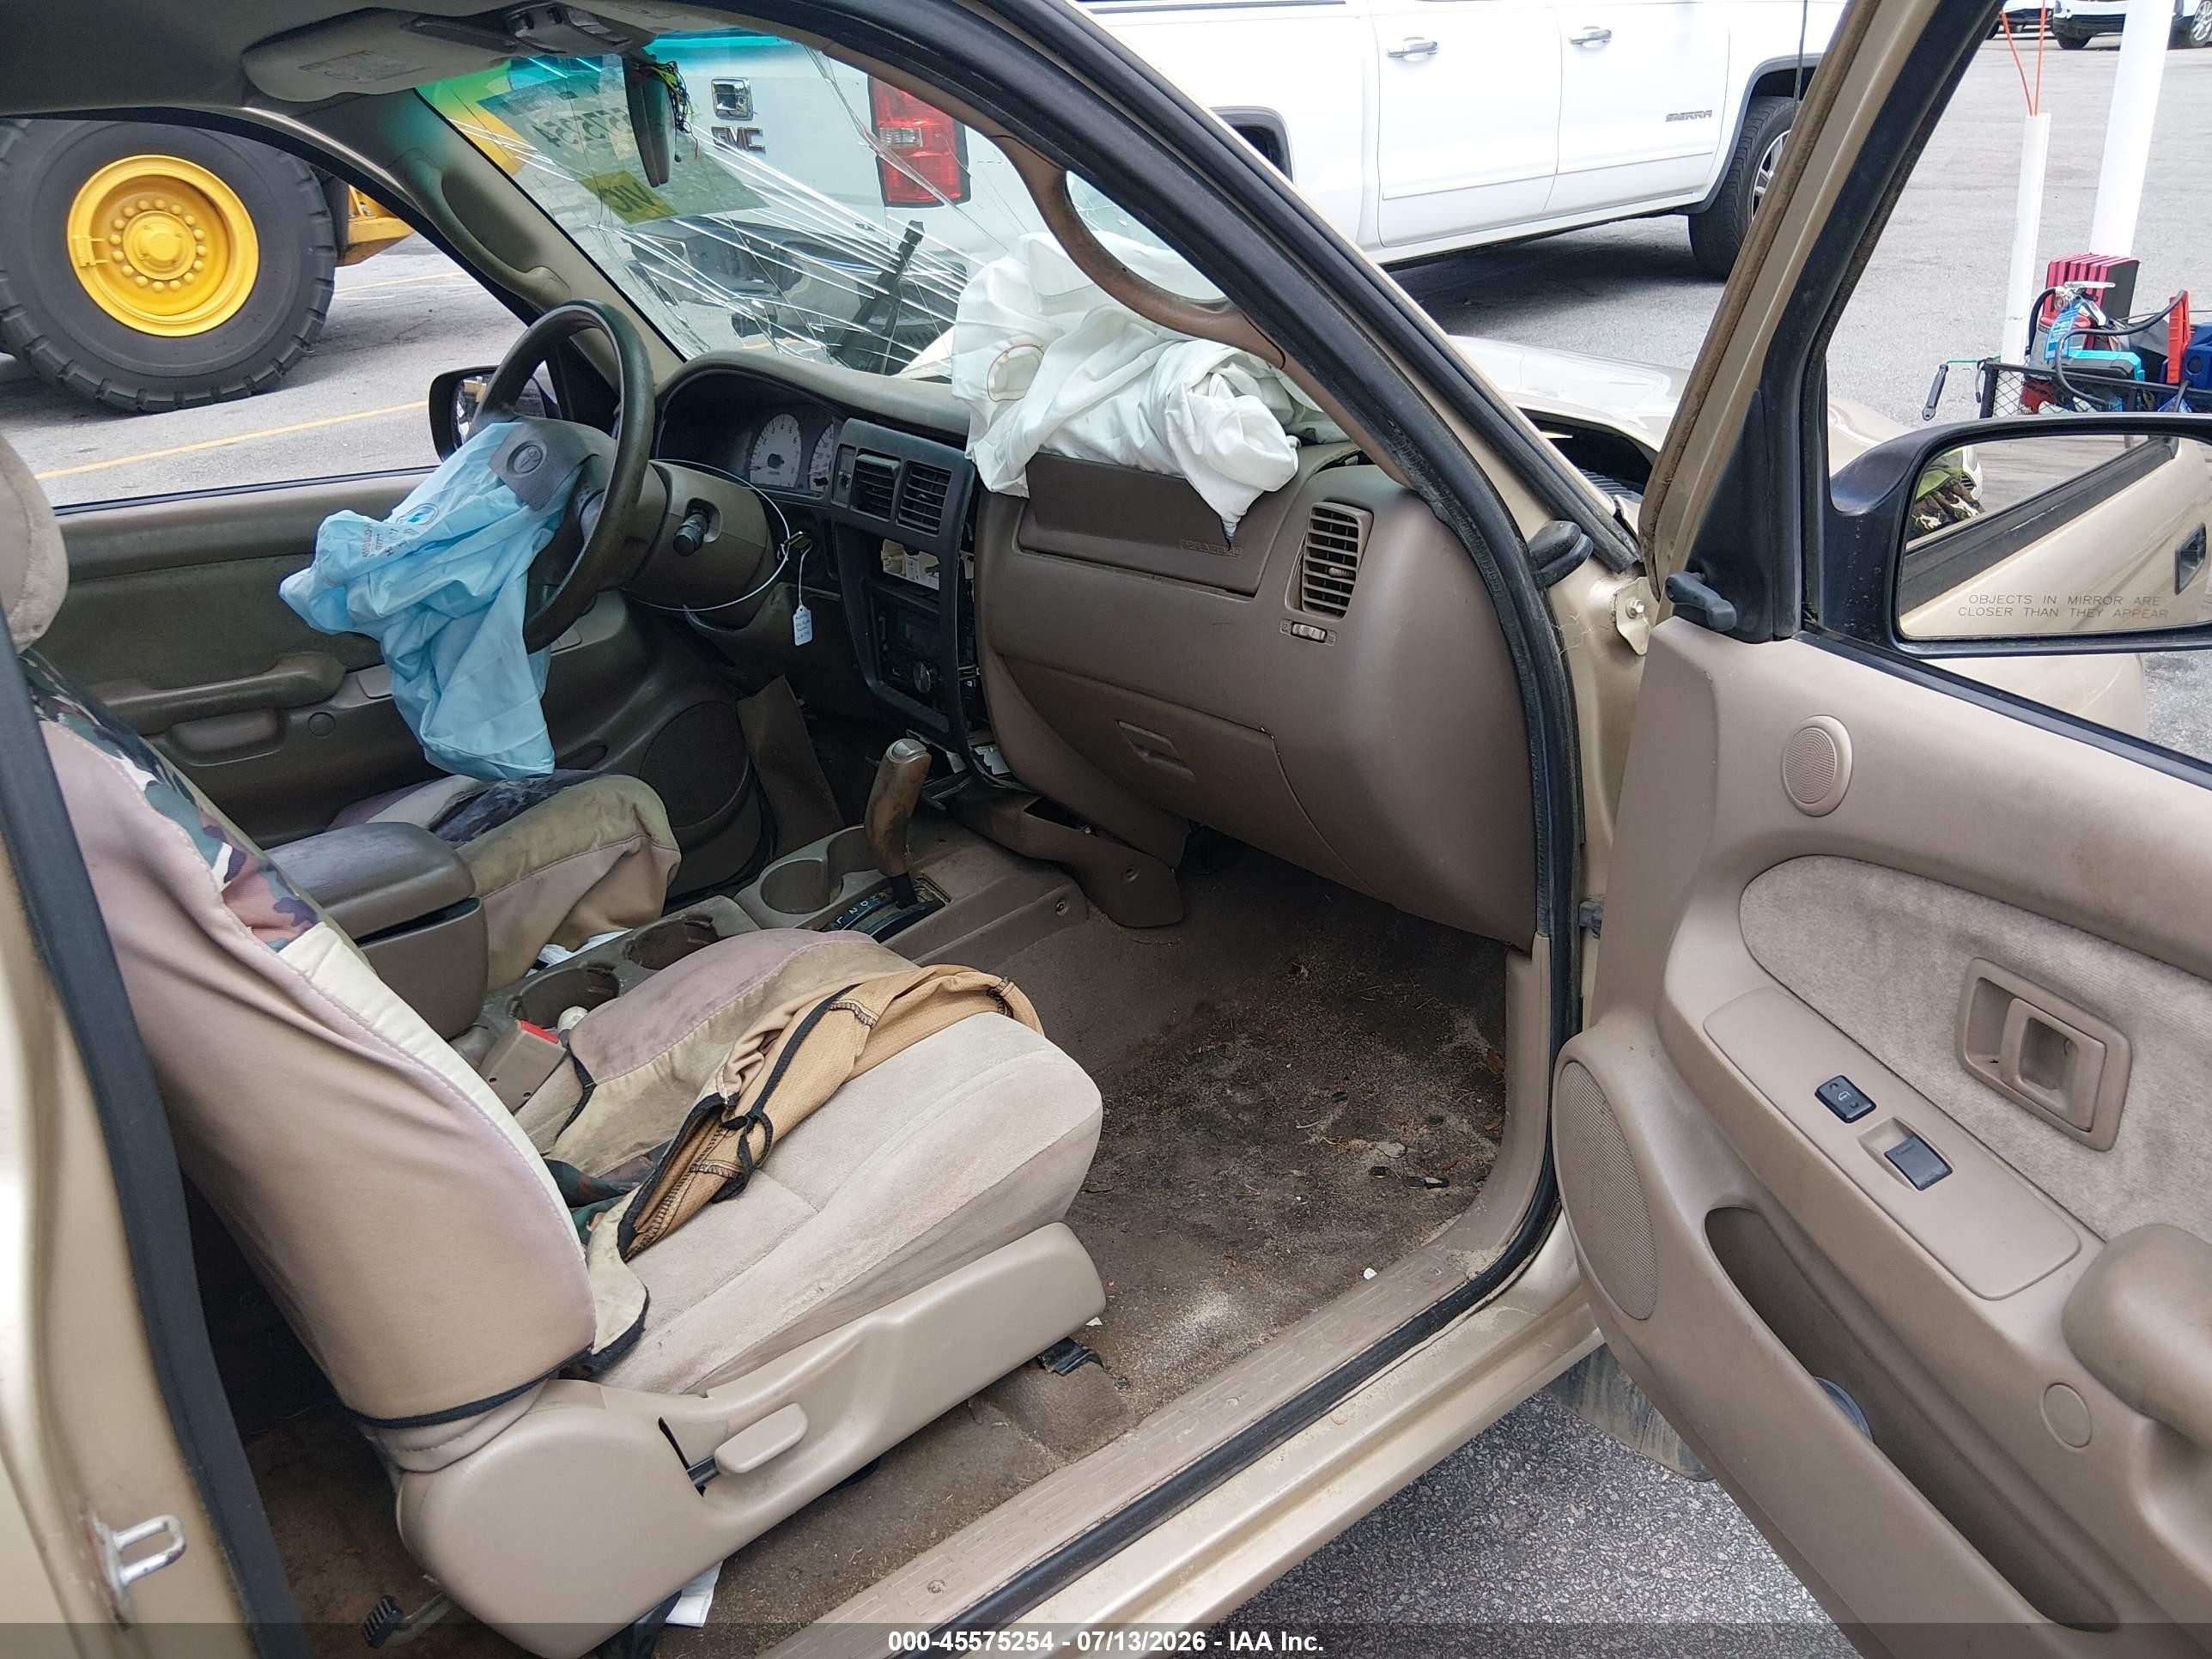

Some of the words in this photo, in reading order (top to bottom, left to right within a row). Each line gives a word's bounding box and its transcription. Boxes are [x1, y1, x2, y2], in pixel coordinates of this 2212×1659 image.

[1666, 110, 1712, 122] SIERRA
[711, 126, 766, 154] GMC
[1968, 594, 2033, 605] OBJECTS
[2043, 595, 2057, 604] IN
[2067, 595, 2124, 605] MIRROR
[2132, 596, 2161, 606] ARE
[1958, 606, 2014, 617] CLOSER
[2022, 607, 2059, 617] THAN
[2069, 607, 2104, 618] THEY
[2112, 608, 2169, 619] APPEAR
